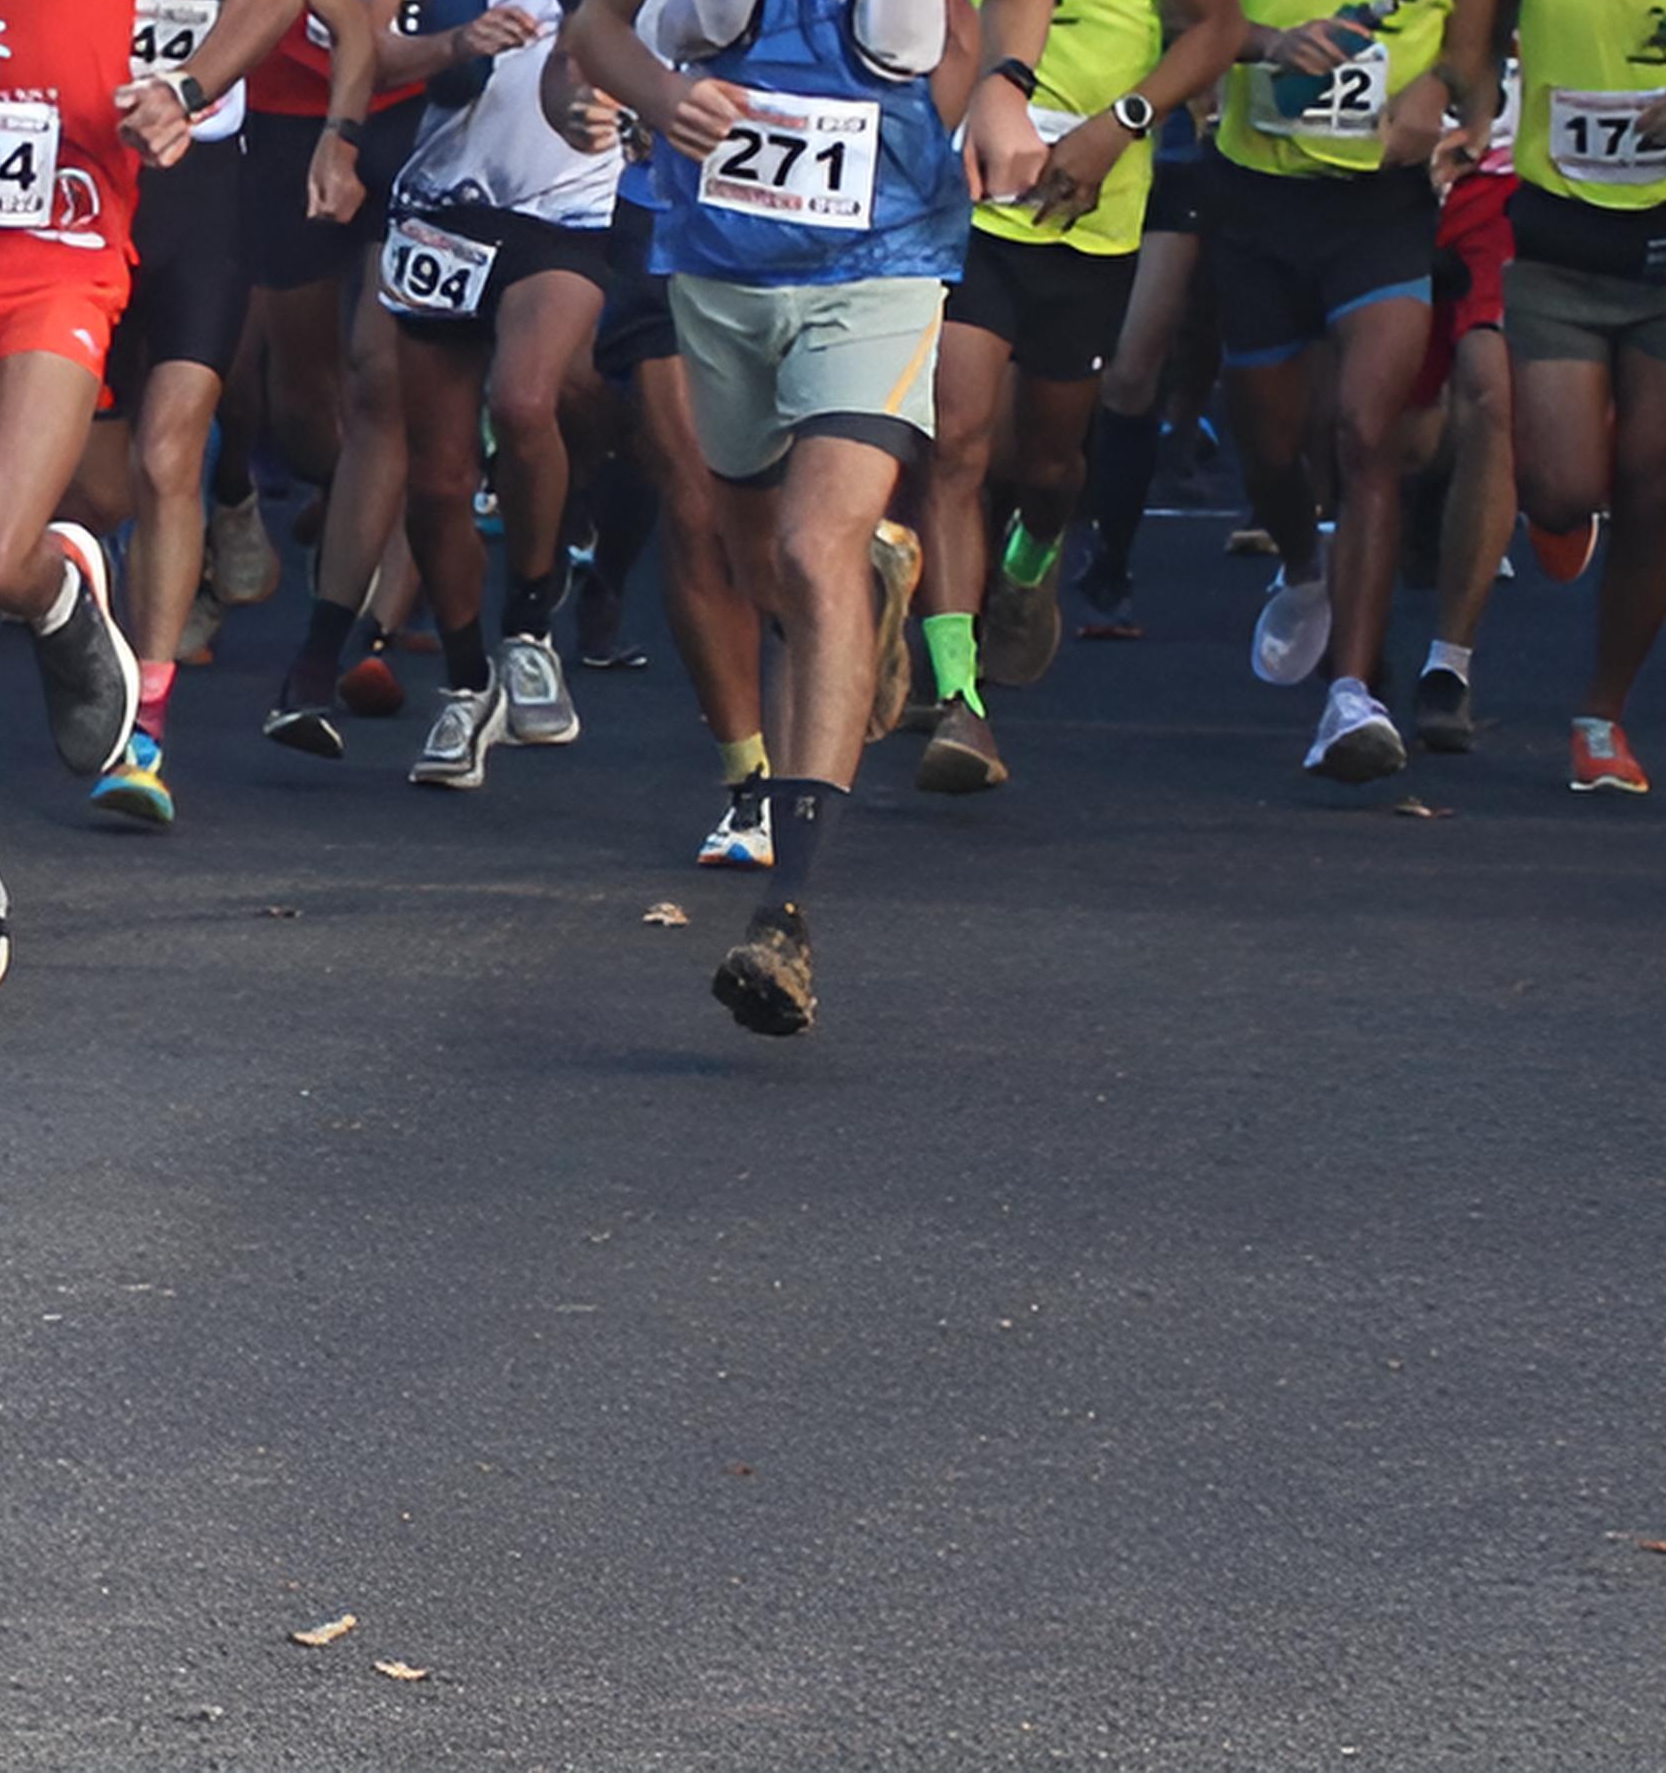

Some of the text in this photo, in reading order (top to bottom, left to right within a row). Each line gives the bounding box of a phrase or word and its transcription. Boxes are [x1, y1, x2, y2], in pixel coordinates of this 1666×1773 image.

[130, 25, 193, 63] 44
[719, 128, 845, 191] 271
[394, 245, 471, 308] 194
